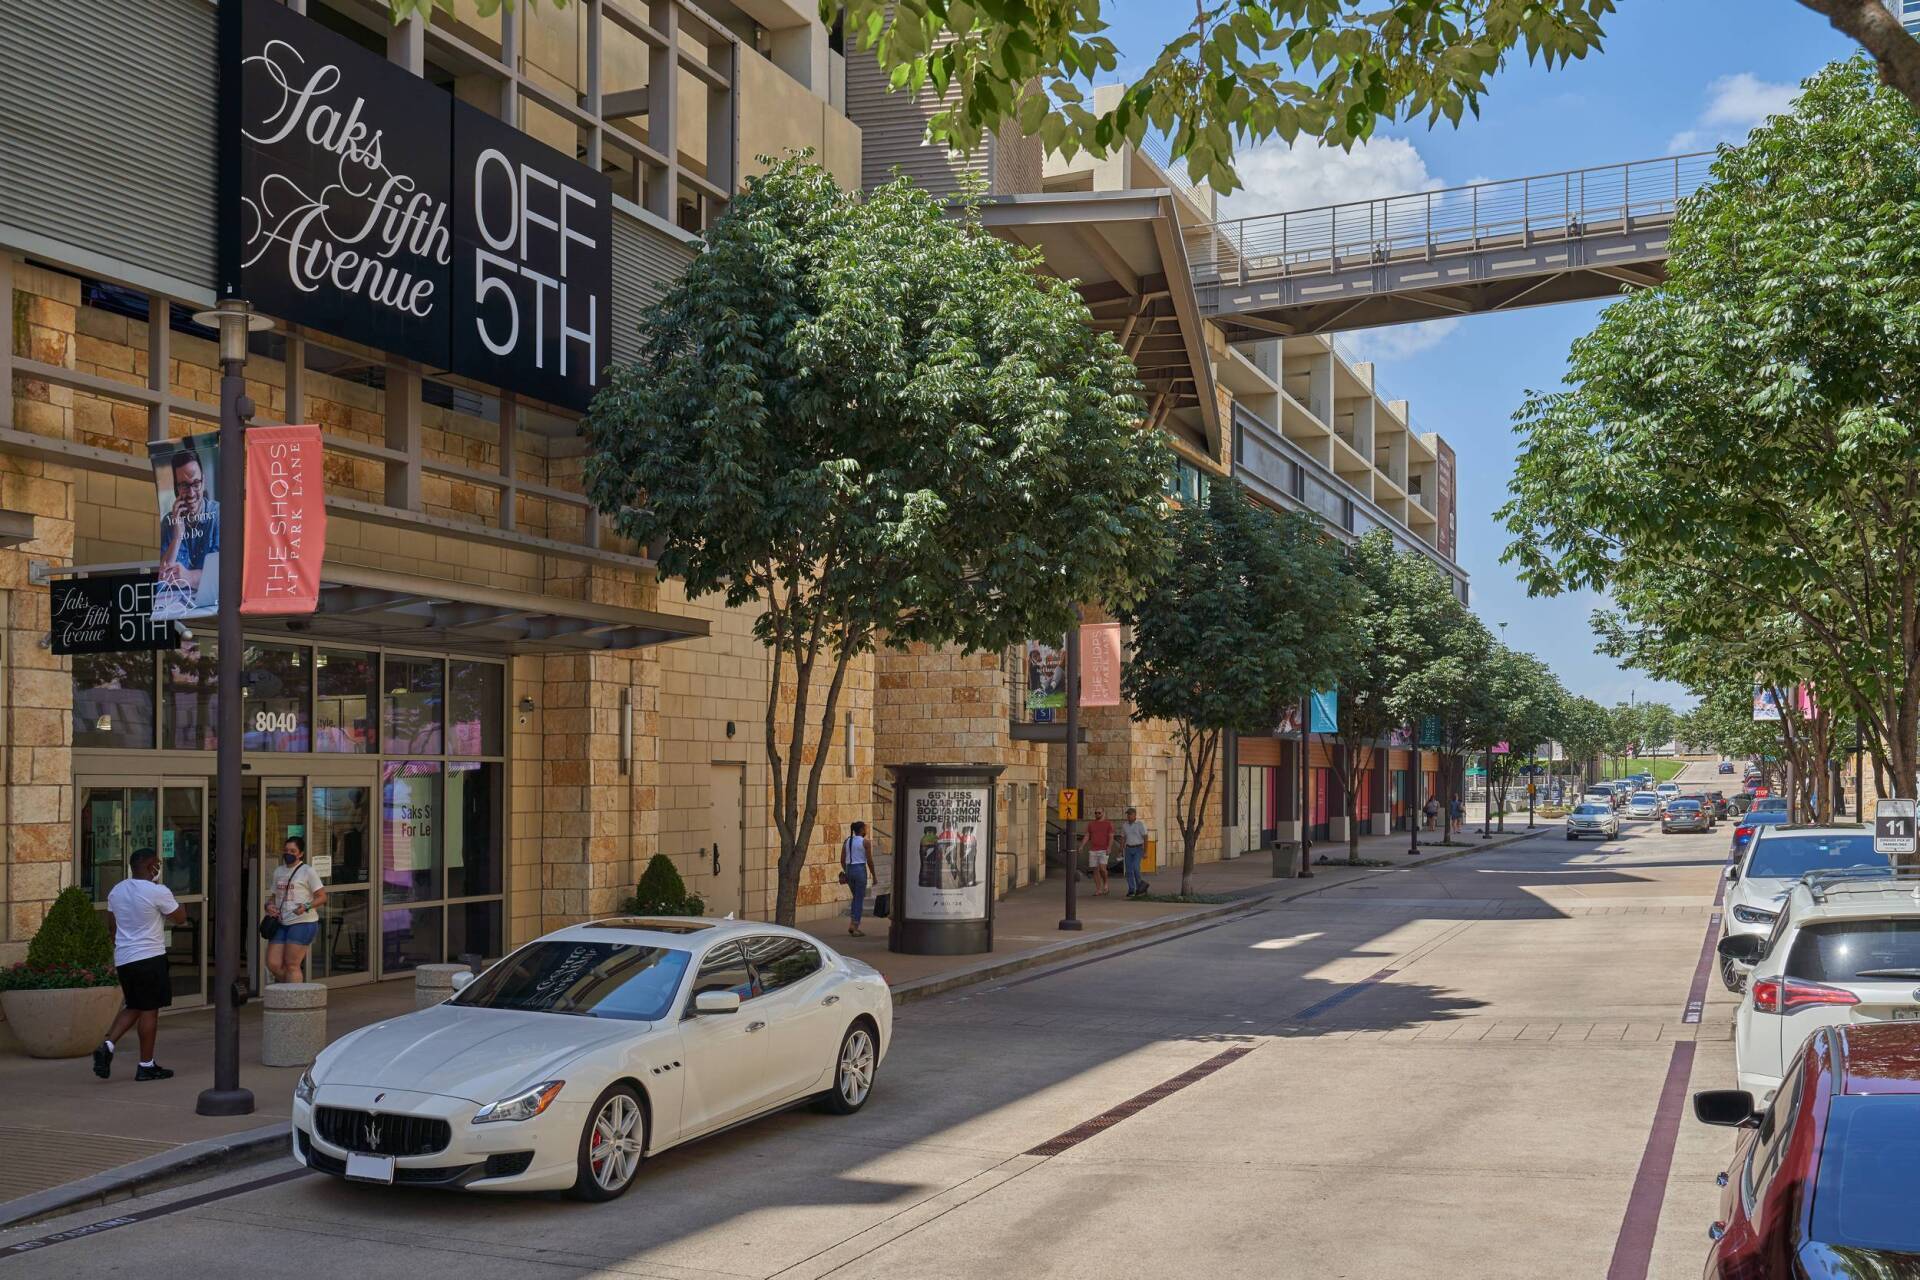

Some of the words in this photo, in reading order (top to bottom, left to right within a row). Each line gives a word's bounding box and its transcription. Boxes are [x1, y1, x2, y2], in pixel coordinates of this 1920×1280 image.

[241, 39, 383, 170] Saks
[319, 148, 451, 266] Fifth
[474, 148, 597, 278] OFF
[241, 173, 435, 317] Avenue
[475, 247, 597, 387] 5TH
[290, 442, 303, 496] LANE
[270, 443, 289, 536] SHOPS
[191, 527, 204, 539] Do
[289, 510, 303, 560] PARK
[266, 546, 288, 597] THE
[287, 570, 299, 596] AT
[52, 586, 90, 617] Saks
[56, 620, 107, 647] Avenue
[119, 612, 168, 642] 5TH
[1091, 630, 1103, 673] SHOPS
[1091, 676, 1103, 699] THE
[255, 711, 297, 733] 8040
[916, 799, 953, 807] SUGAR
[956, 799, 982, 807] THAN
[947, 791, 972, 800] LESS
[401, 804, 423, 820] Saks
[401, 823, 417, 838] For
[1885, 820, 1905, 836] 11
